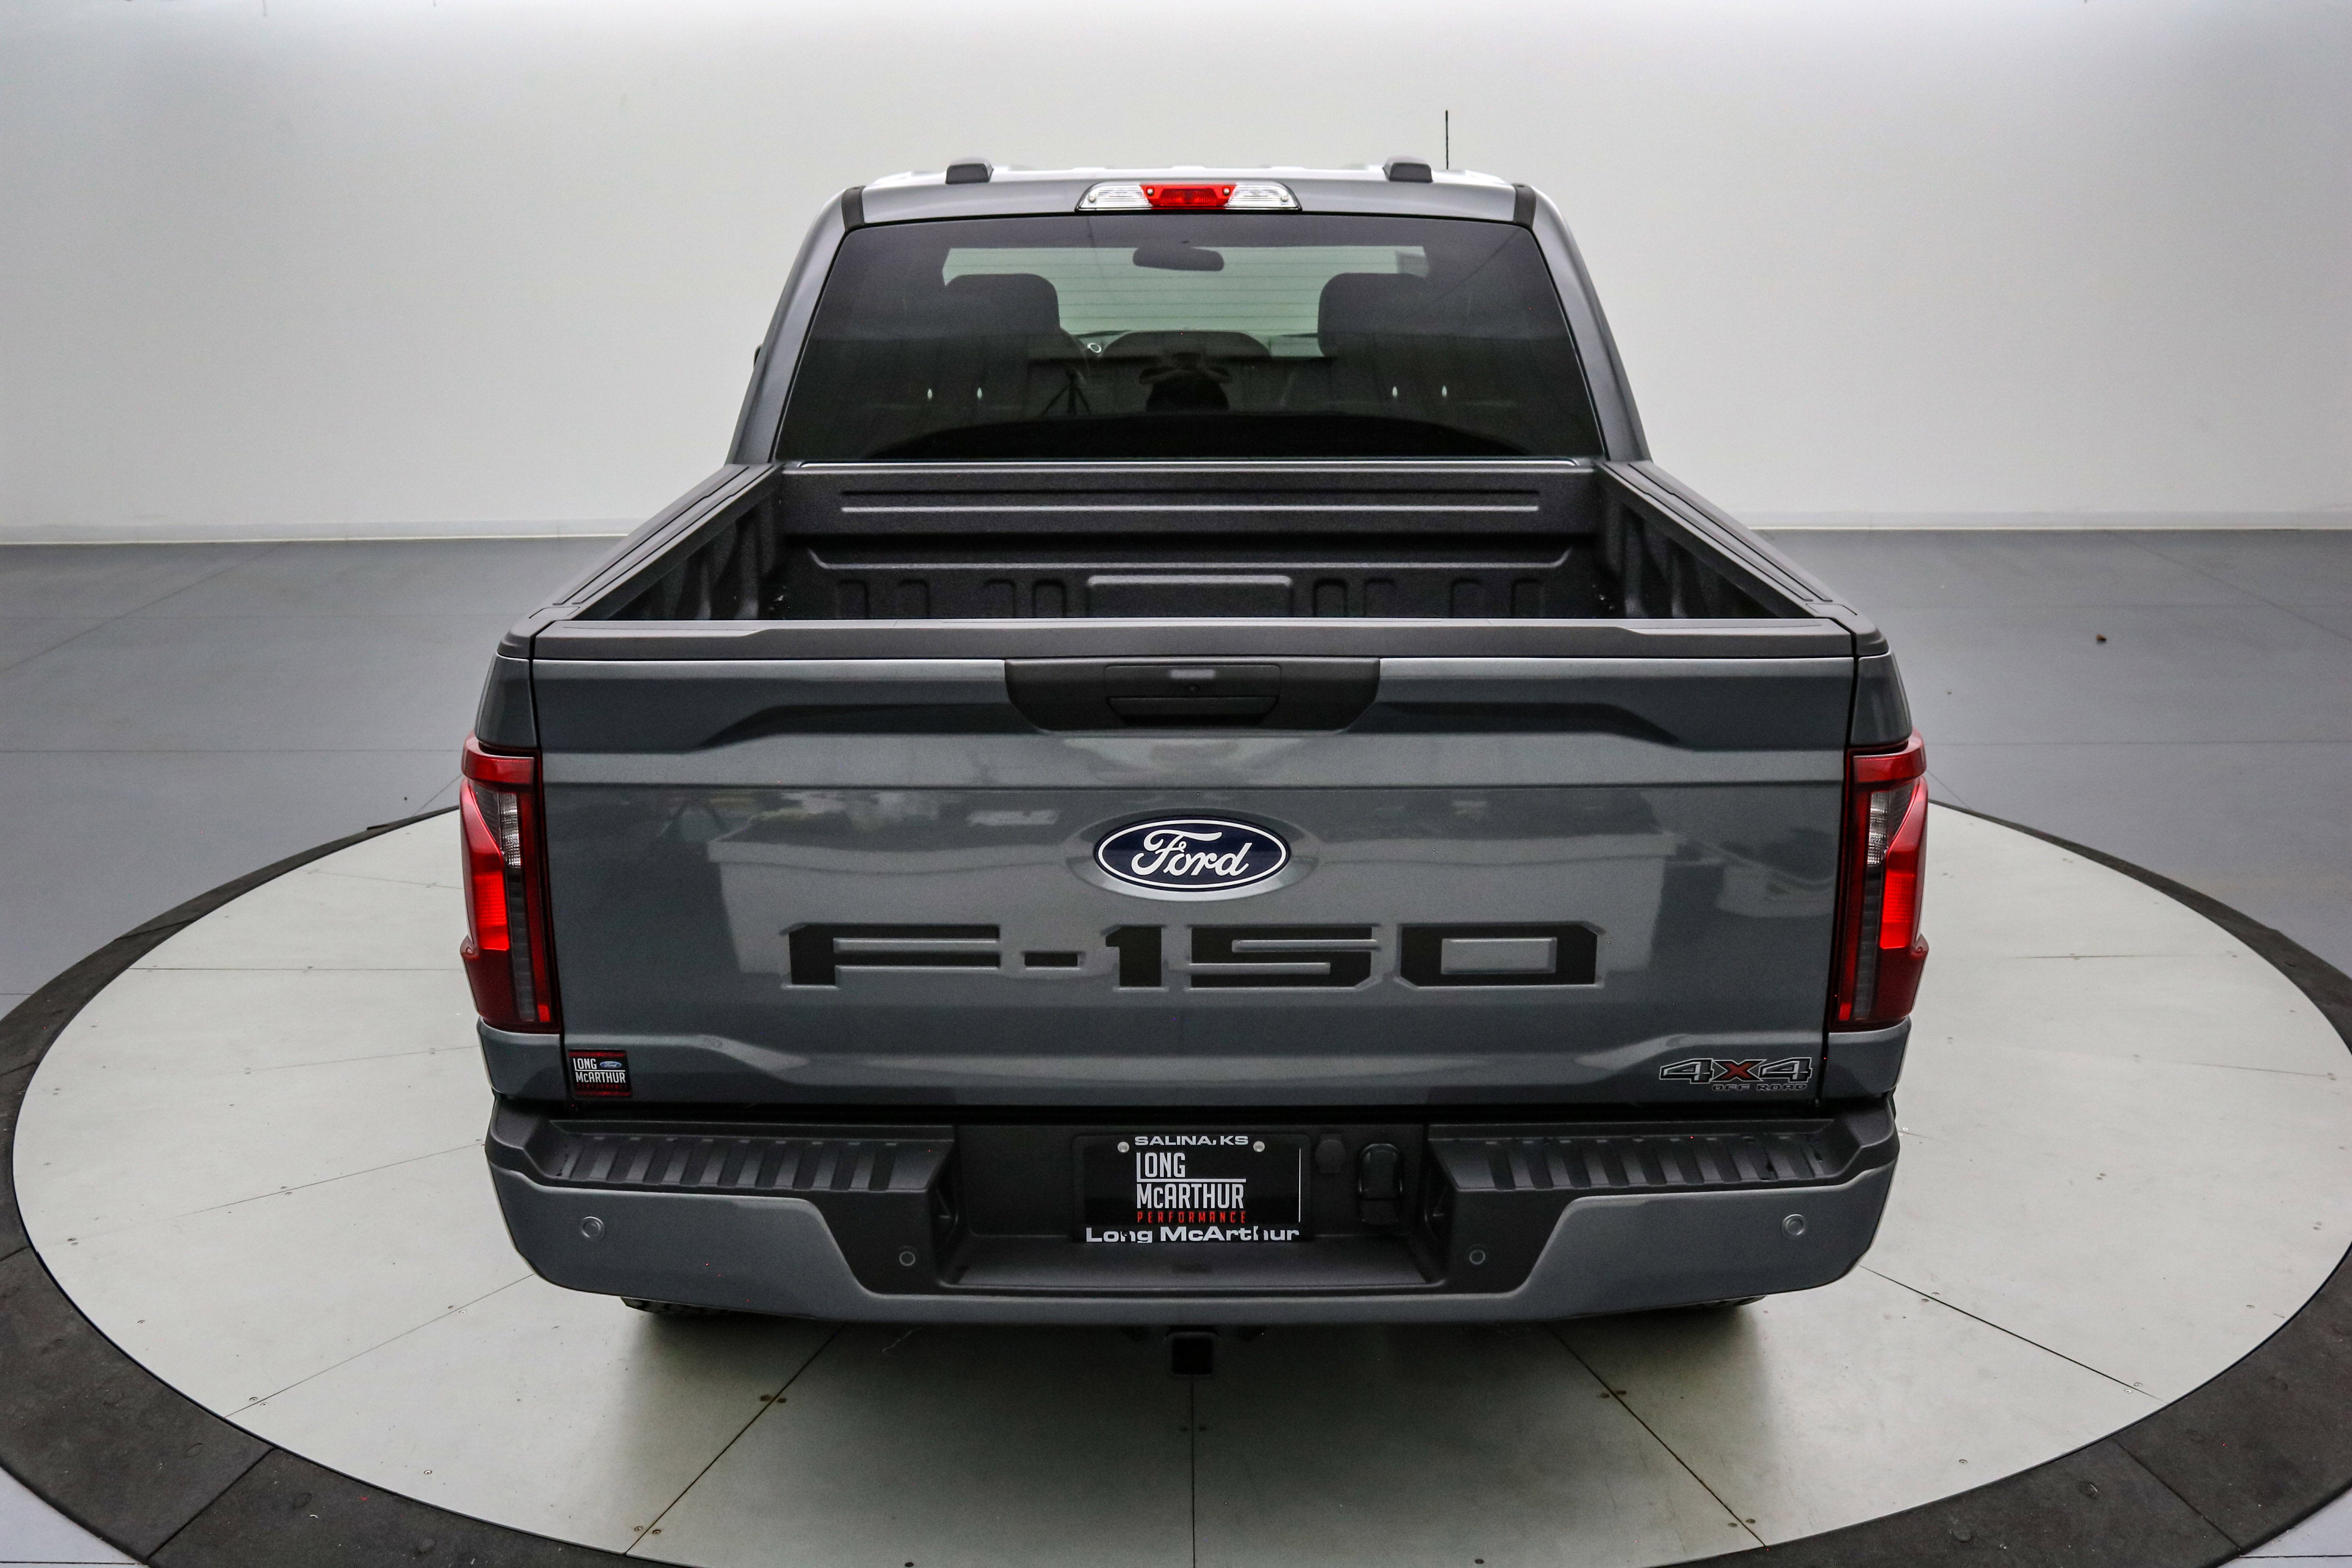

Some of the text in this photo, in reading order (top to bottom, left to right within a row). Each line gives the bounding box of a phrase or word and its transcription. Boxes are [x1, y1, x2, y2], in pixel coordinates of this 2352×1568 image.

[1131, 829, 1252, 876] Ford
[782, 924, 1605, 988] F-150
[573, 1058, 597, 1071] LONG
[1135, 1136, 1249, 1145] SALINA, KS
[1136, 1152, 1185, 1180] LONG
[1137, 1211, 1246, 1223] PERFORMANCE
